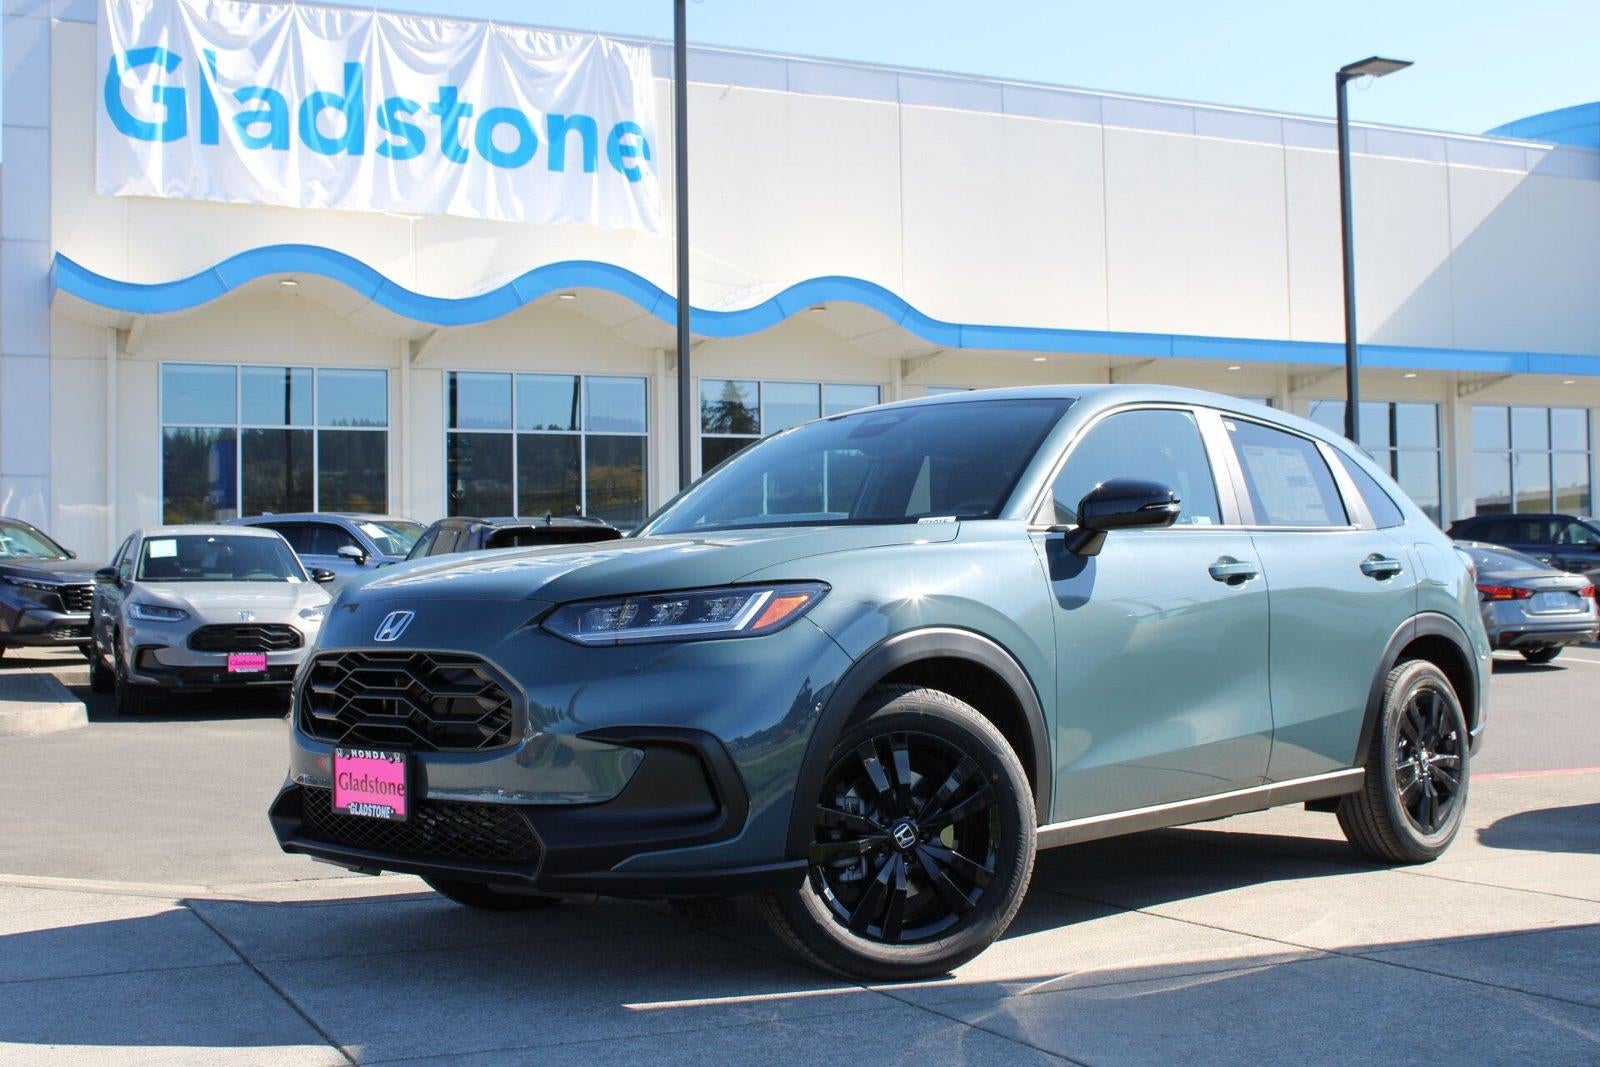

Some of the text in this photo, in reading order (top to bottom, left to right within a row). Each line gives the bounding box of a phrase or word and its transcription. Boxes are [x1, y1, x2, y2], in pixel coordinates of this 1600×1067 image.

[103, 45, 652, 183] Gladstone
[351, 749, 386, 759] HONDA
[338, 772, 405, 797] Gladstone
[349, 802, 391, 818] GLADSTONE
